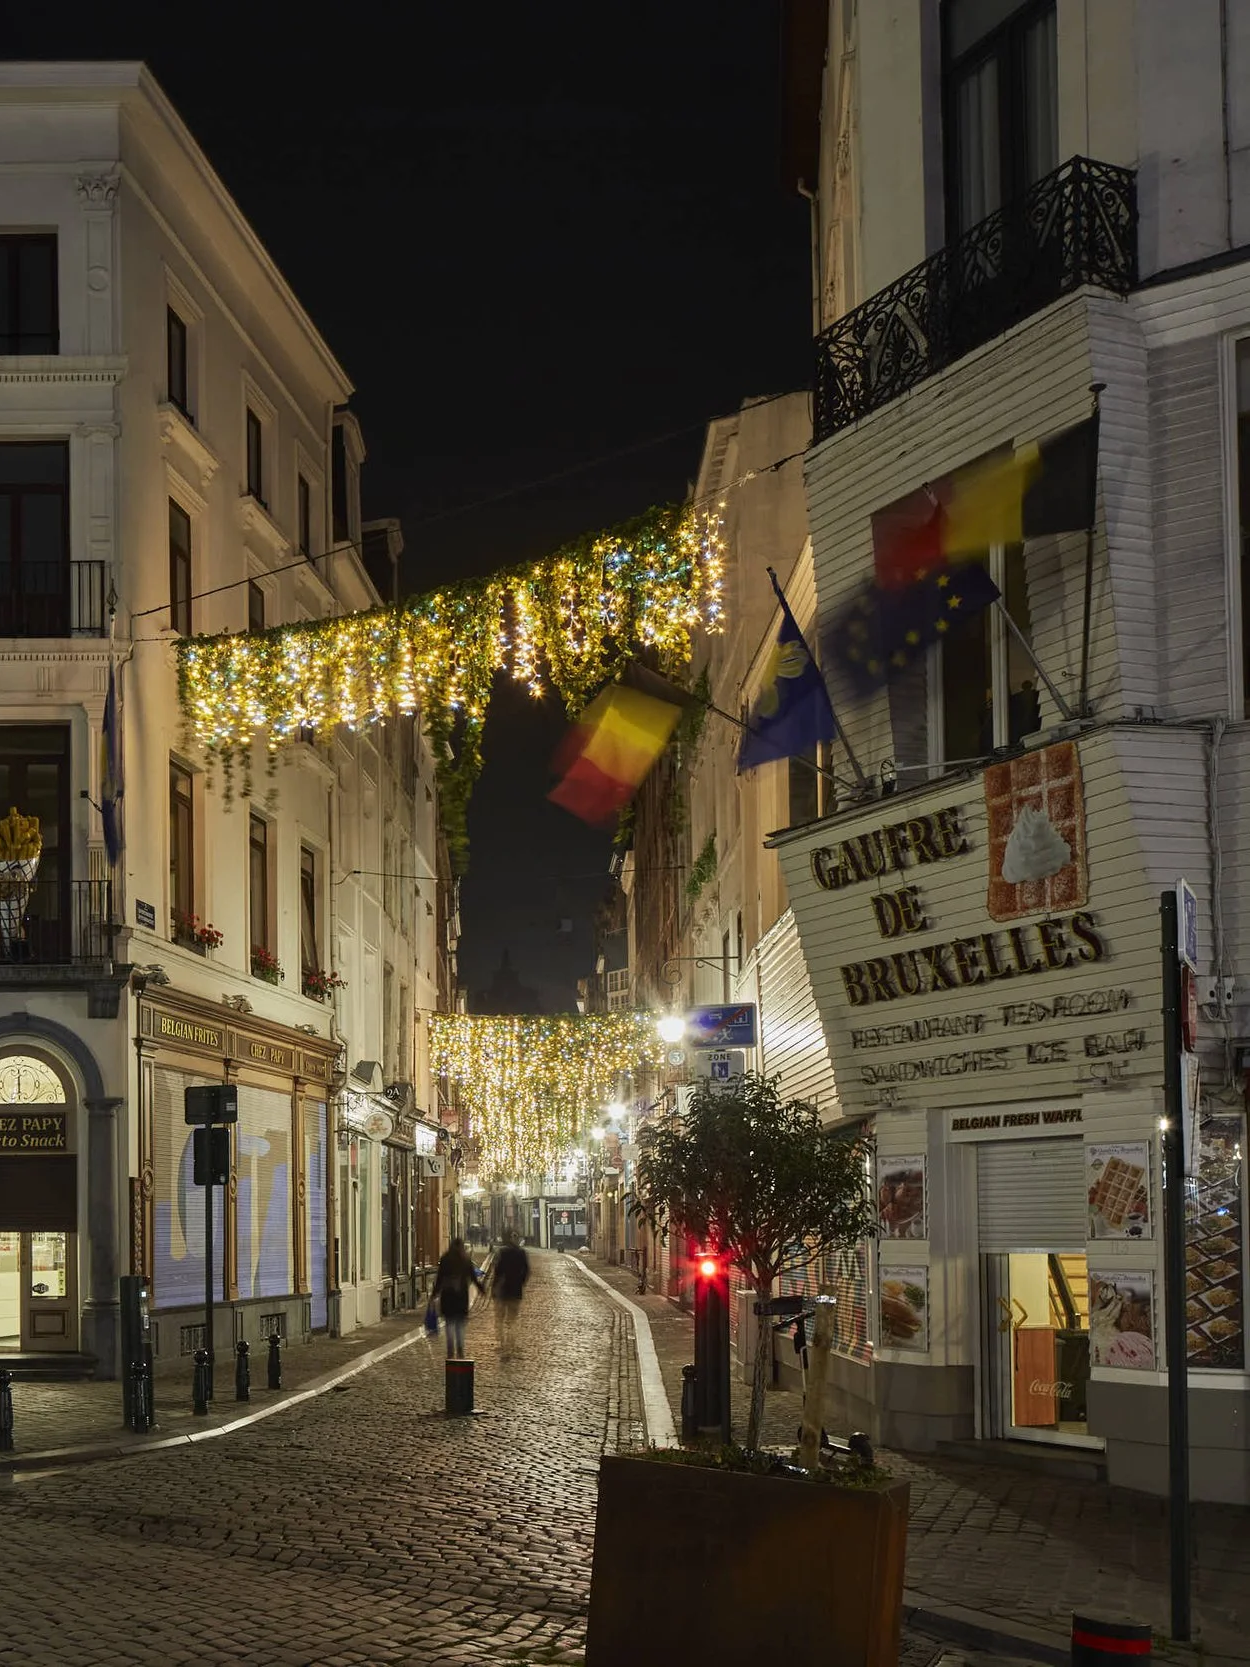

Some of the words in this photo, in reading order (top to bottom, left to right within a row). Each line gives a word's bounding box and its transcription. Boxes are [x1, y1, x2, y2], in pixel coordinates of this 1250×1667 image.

[810, 807, 968, 890] GAUFRE
[871, 885, 927, 938] DE
[840, 911, 1103, 1006] BRUXELLES
[161, 1017, 194, 1040] BELGIAN
[194, 1026, 219, 1048] FRITES
[250, 1042, 266, 1060] CHEZ
[270, 1048, 284, 1065] PAPY
[386, 1086, 400, 1099] 2A
[22, 1117, 63, 1131] PAPY
[951, 1115, 1001, 1131] BELGIAN
[1002, 1112, 1040, 1127] FRESH
[20, 1133, 65, 1147] Snack
